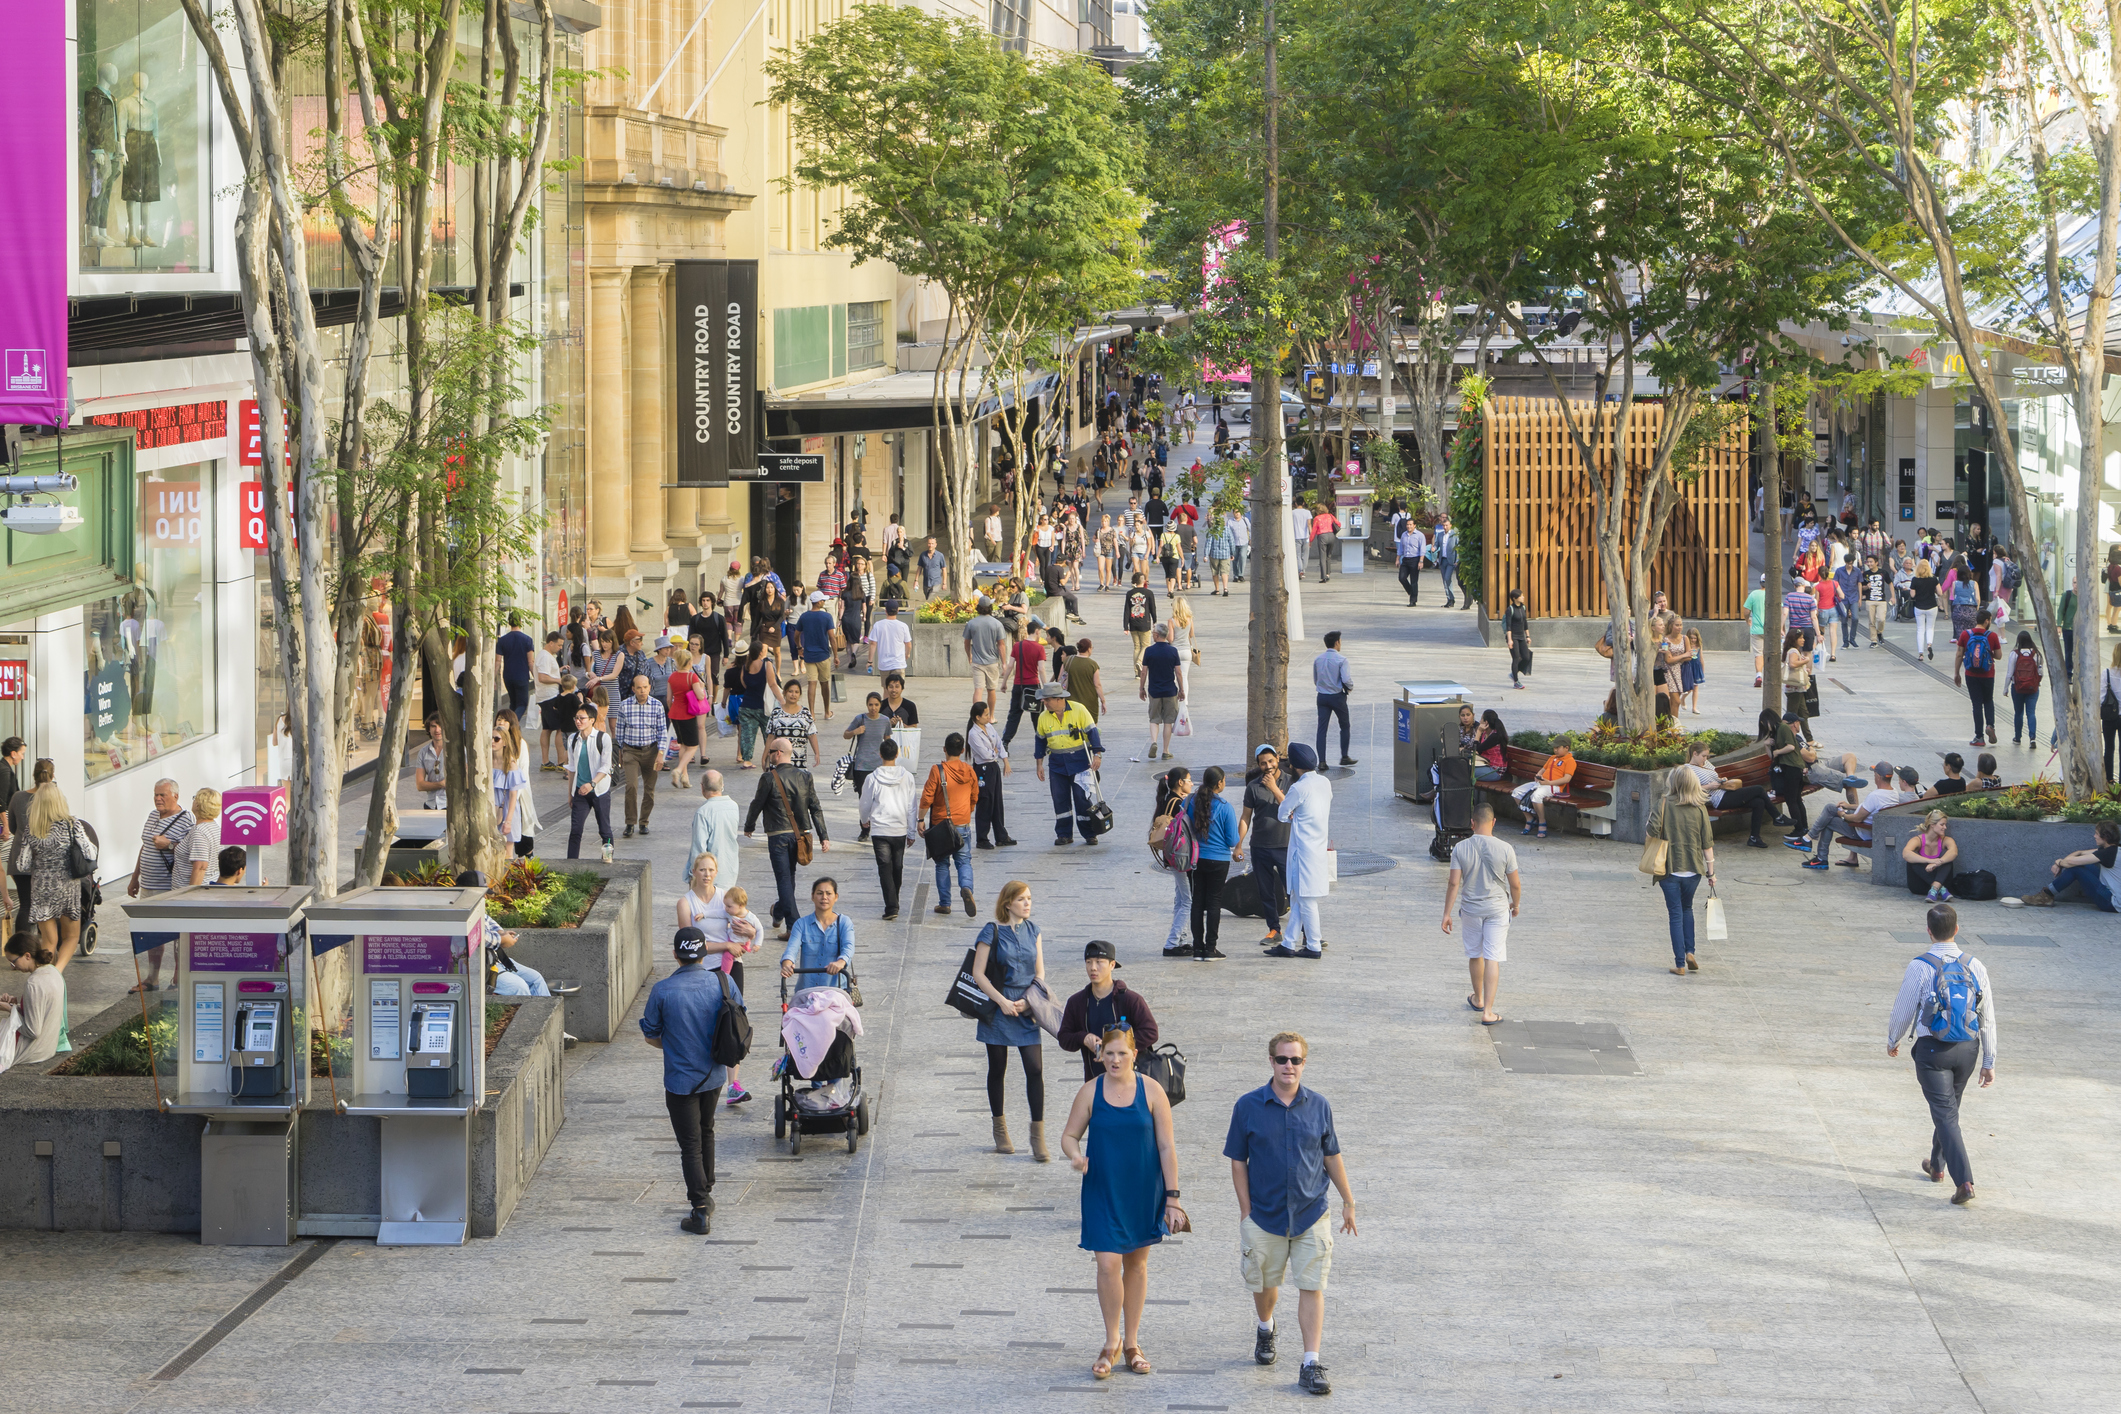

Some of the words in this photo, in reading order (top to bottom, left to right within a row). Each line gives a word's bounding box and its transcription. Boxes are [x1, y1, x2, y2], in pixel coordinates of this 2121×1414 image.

[695, 304, 709, 354] ROAD
[727, 302, 741, 349] ROAD
[2012, 366, 2068, 378] STRI
[695, 357, 710, 443] COUNTRY
[727, 352, 741, 434] COUNTRY
[156, 425, 181, 447] COLOUR
[794, 457, 818, 465] deposit
[98, 681, 113, 695] Colour
[98, 698, 111, 711] Worn
